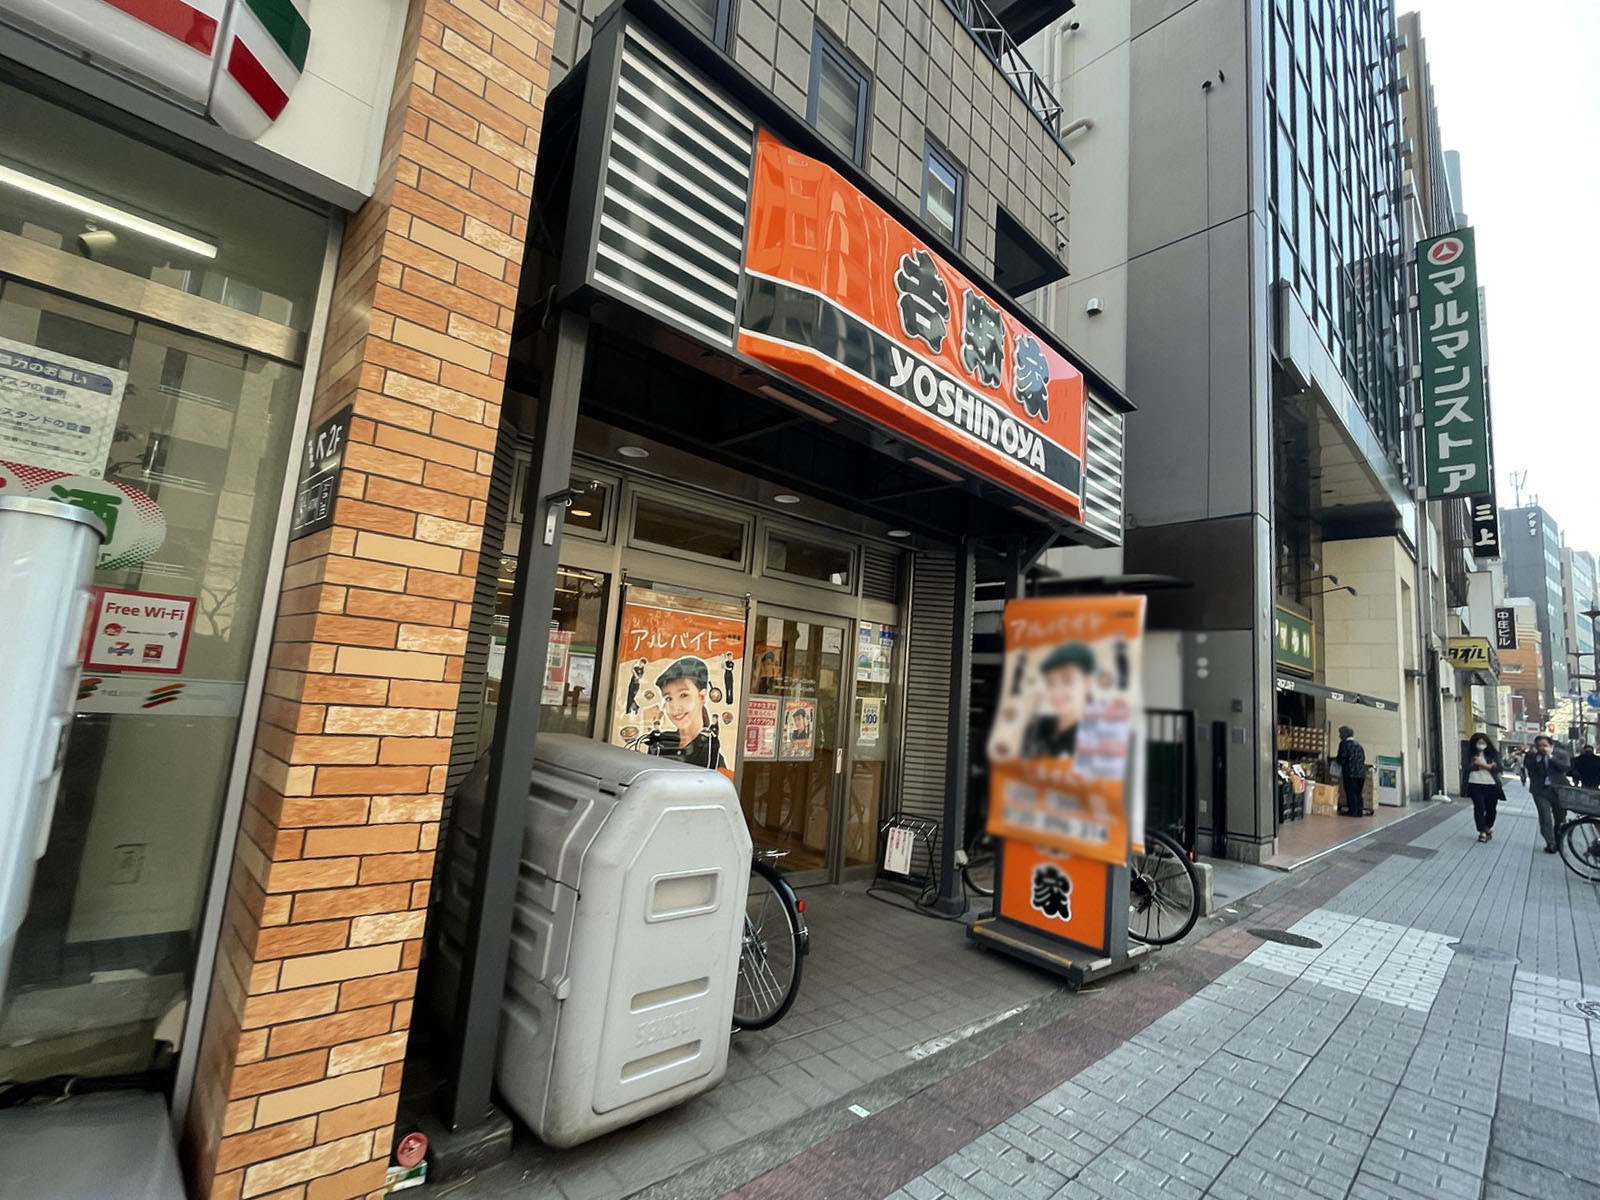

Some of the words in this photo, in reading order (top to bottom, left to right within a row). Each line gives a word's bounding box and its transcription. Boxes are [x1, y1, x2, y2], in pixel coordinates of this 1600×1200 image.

[1427, 265, 1476, 494] マルマンストア
[888, 346, 1047, 473] YOSHINOYA
[1474, 503, 1497, 547] 三上
[105, 602, 140, 616] Free
[145, 606, 184, 620] Wi-Fi
[631, 629, 720, 651] アルバイト
[1031, 862, 1072, 921] 家
